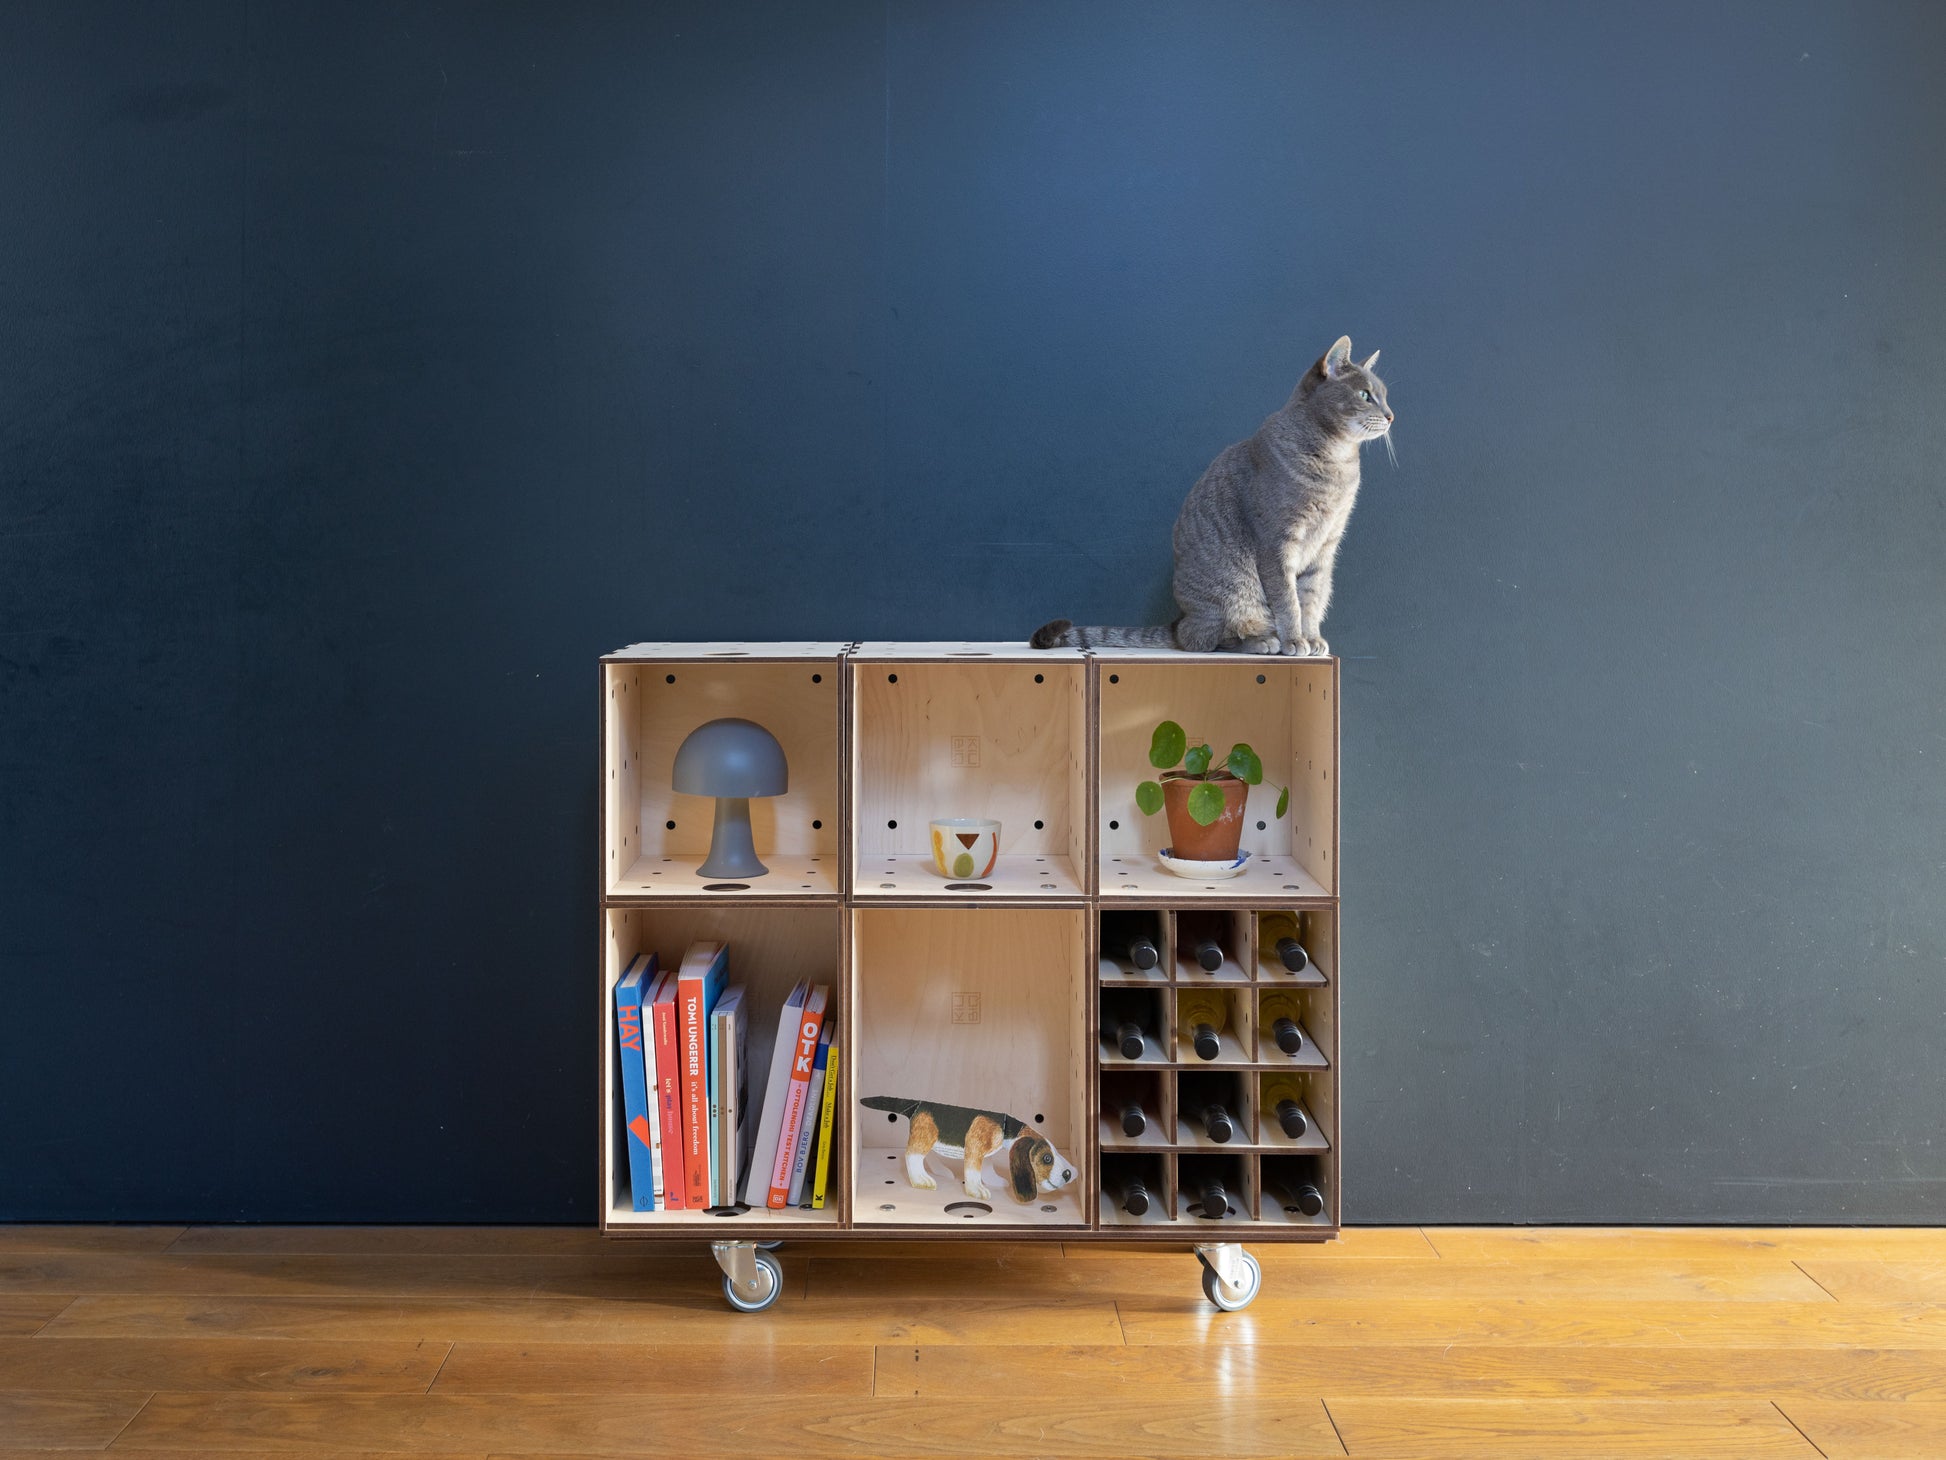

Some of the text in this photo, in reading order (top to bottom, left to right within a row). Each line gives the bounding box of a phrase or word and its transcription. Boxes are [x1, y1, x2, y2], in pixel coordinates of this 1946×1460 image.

[619, 1005, 641, 1051] HAY
[687, 996, 699, 1076] TOMI UNGERER
[665, 1078, 673, 1094] let's
[691, 1093, 699, 1103] all
[691, 1104, 699, 1124] about
[692, 1125, 700, 1155] freedom
[779, 1089, 802, 1182] OTTOLENGHI TEST KITCHEN
